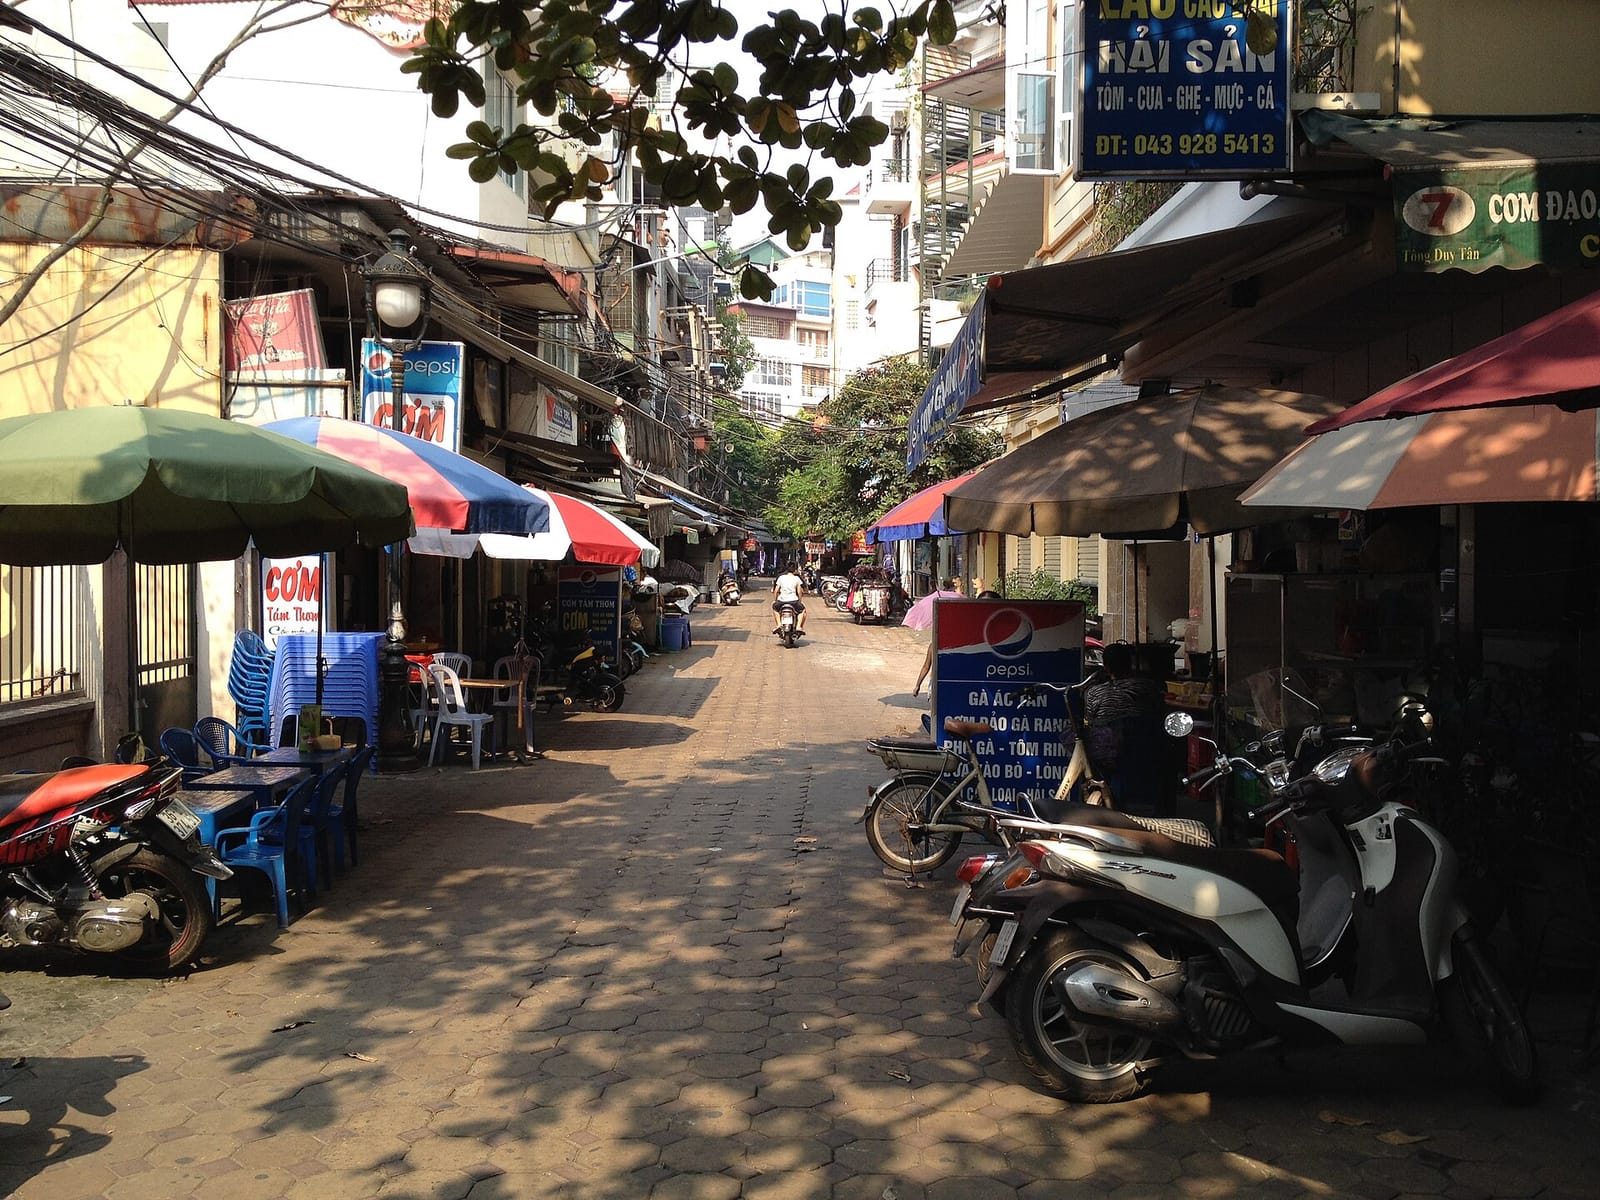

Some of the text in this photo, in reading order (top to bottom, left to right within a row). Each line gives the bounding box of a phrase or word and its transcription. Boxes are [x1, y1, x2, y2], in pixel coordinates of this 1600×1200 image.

[1099, 25, 1275, 73] HẢI SẢN
[1097, 81, 1124, 111] TÔM
[1137, 86, 1163, 111] CUA
[1176, 85, 1201, 115] GHẸ
[1214, 82, 1244, 115] MỰC
[1256, 80, 1275, 110] CÁ
[1096, 133, 1275, 155] ĐT: 043 928 5413
[1422, 193, 1455, 228] 7
[1488, 191, 1541, 224] CƠM
[1434, 248, 1455, 265] Duy
[1459, 246, 1480, 261] Tân
[266, 559, 320, 602] CƠM
[267, 606, 291, 622] Tám
[986, 663, 1030, 679] pepsi
[968, 688, 989, 706] GÀ
[993, 689, 1014, 707] ÁC
[1011, 714, 1030, 732] GÀ
[976, 738, 995, 755] GÀ
[1009, 738, 1039, 756] TÔM
[979, 761, 1001, 778] ÀO
[1004, 761, 1023, 779] BÒ
[991, 787, 1016, 805] LOẠI
